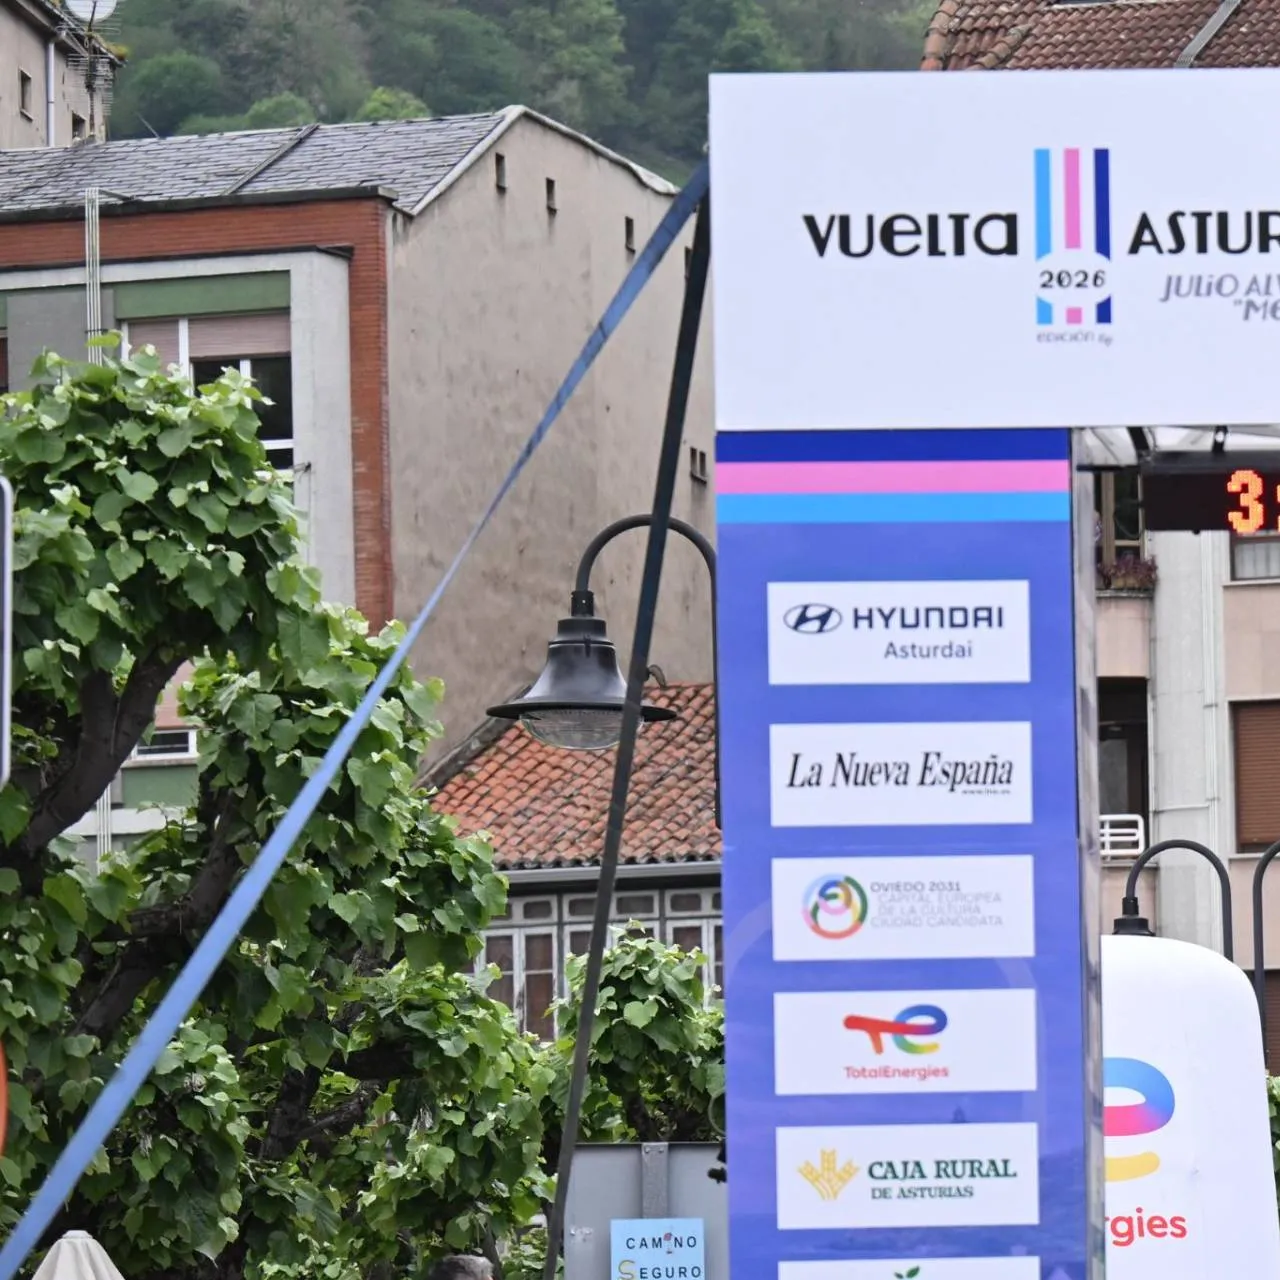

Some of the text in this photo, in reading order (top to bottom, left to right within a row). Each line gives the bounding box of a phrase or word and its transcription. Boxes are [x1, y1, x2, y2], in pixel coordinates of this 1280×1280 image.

[1040, 270, 1106, 288] 2026
[852, 606, 1003, 630] HYUNDAI
[884, 641, 973, 660] Asturdai
[786, 751, 1014, 793] La Nueva España
[844, 1065, 949, 1081] TotalEnergies
[868, 1158, 1017, 1181] CAJA RURAL
[871, 1185, 974, 1200] DE ASTURIAS
